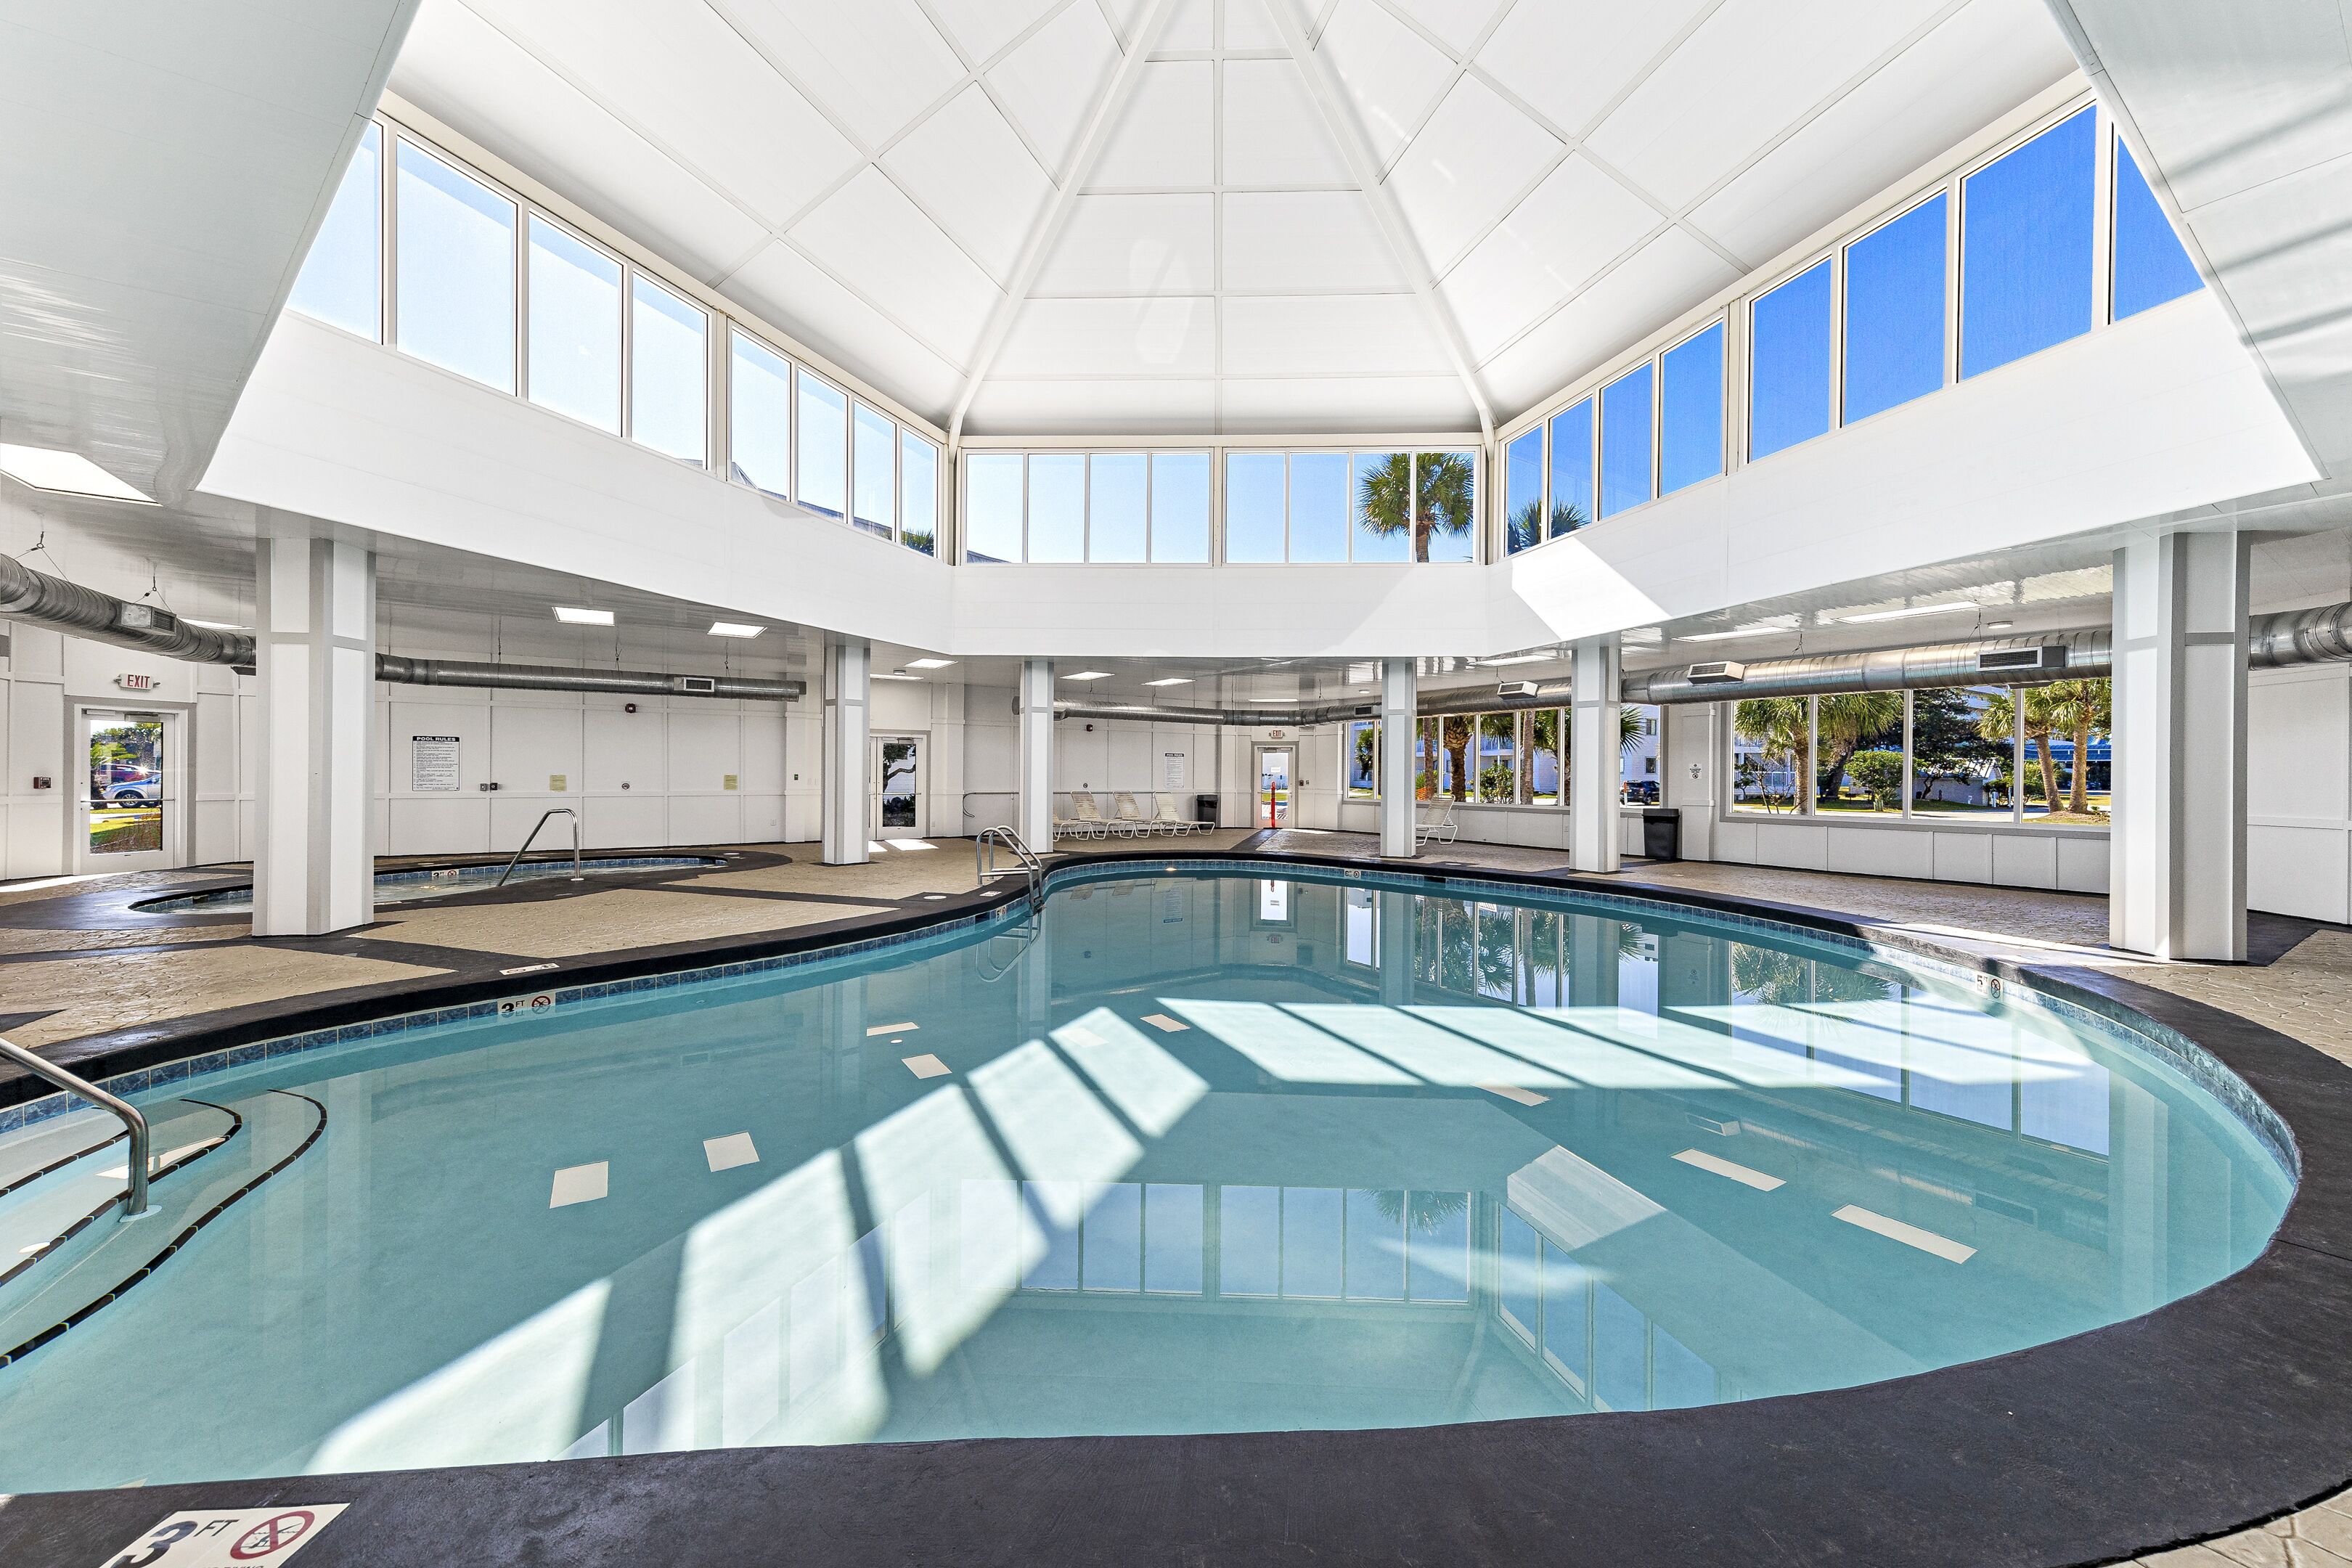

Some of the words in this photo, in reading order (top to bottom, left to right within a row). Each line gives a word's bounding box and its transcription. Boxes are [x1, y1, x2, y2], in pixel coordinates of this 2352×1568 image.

[127, 674, 150, 688] EXIT
[110, 1520, 198, 1568] 3
[192, 1519, 240, 1538] FT
